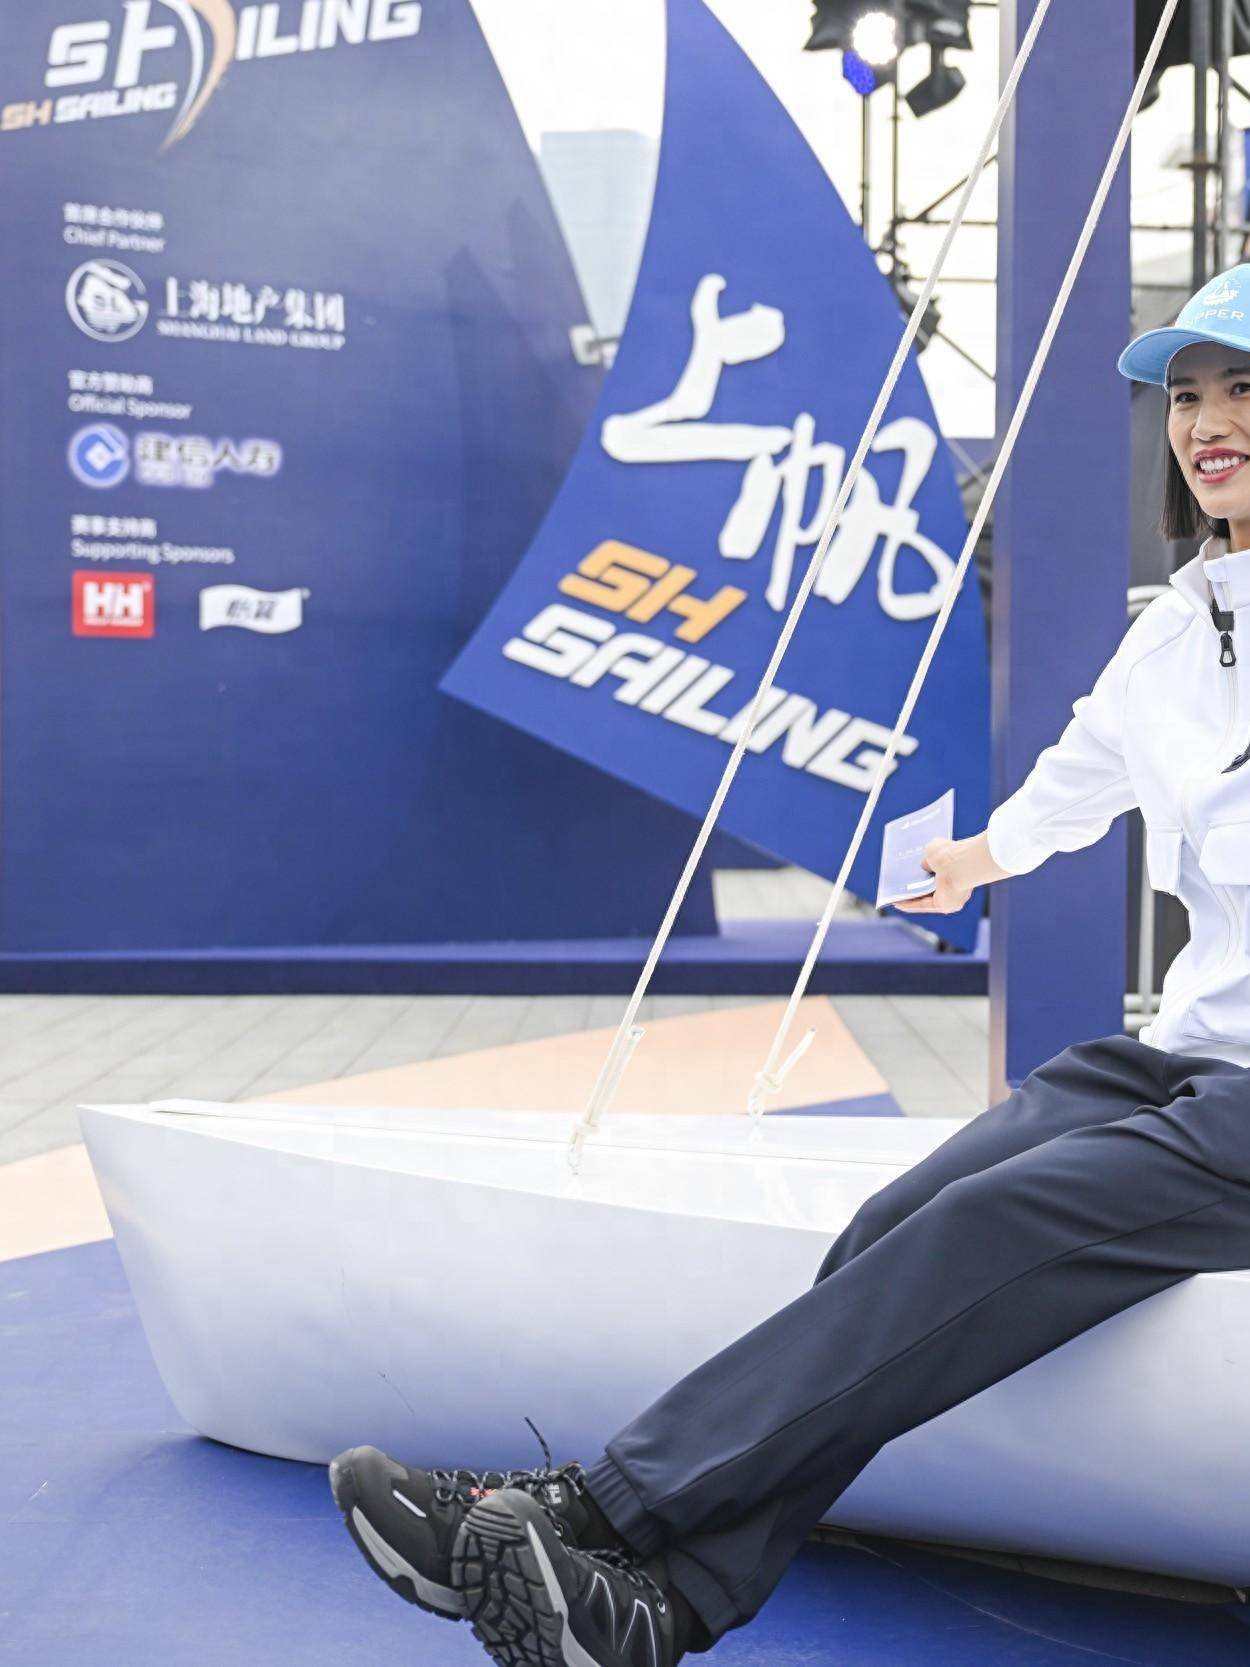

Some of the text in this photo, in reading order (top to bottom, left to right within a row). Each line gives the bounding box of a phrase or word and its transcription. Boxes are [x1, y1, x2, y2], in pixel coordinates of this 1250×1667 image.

[0, 82, 178, 131] SH SAILING
[68, 393, 192, 420] Official Sponsor
[71, 538, 235, 565] Supporting Sponsors
[558, 540, 747, 643] SH
[502, 603, 919, 793] SAILING
